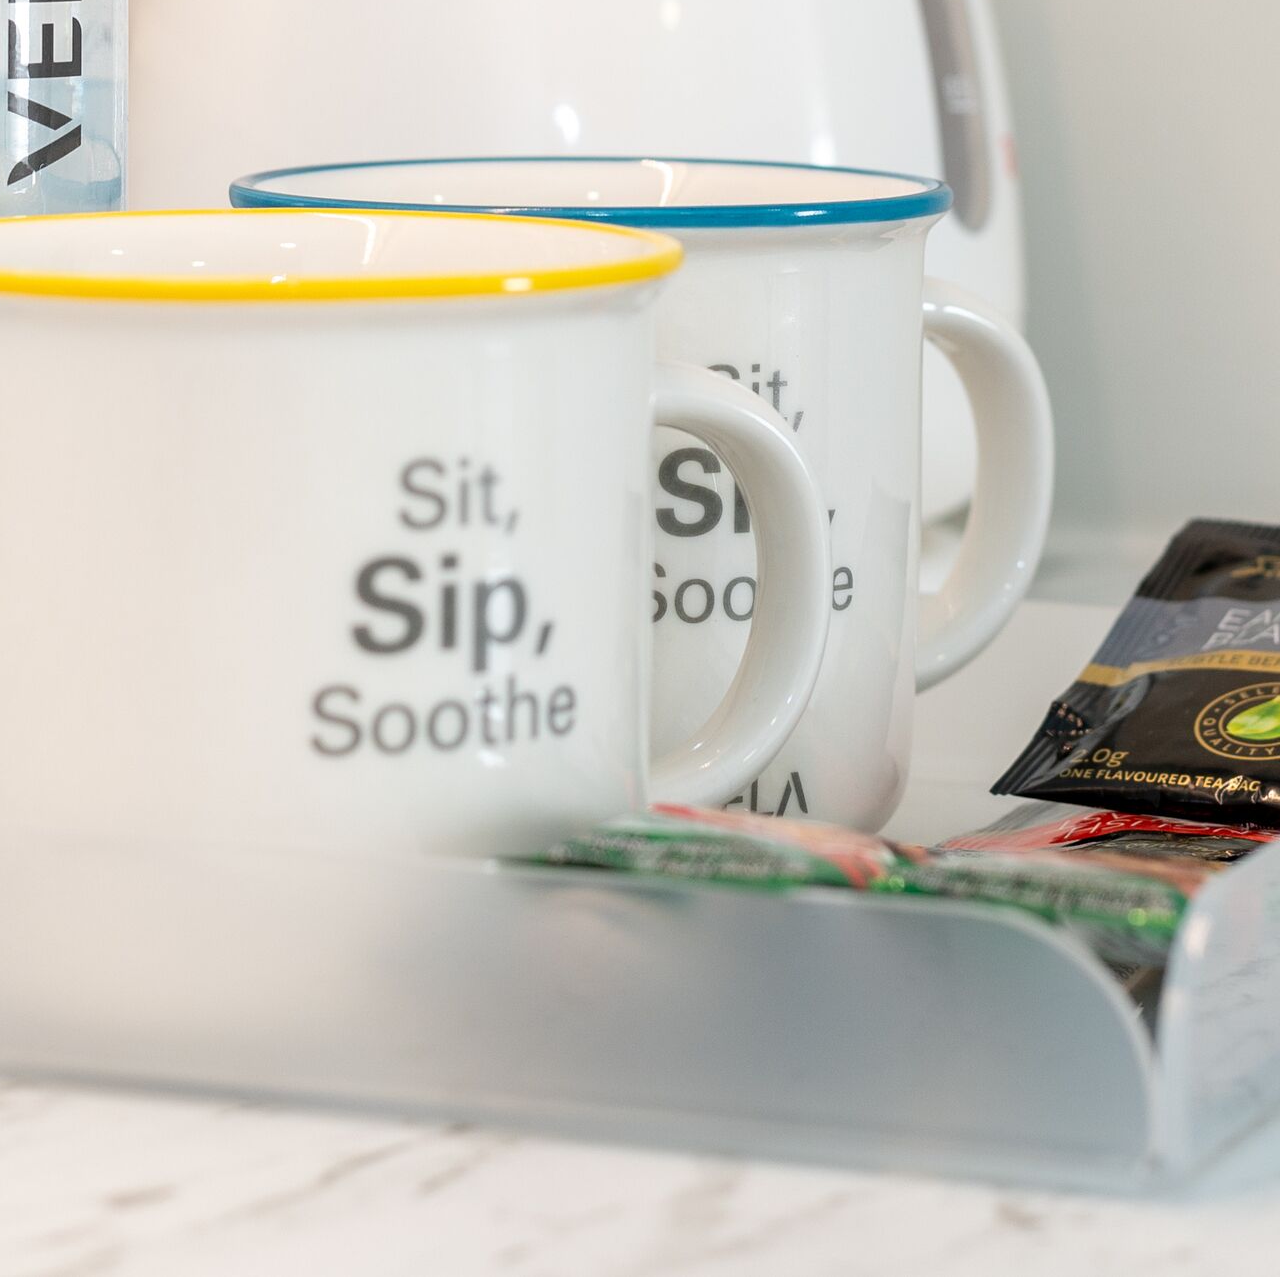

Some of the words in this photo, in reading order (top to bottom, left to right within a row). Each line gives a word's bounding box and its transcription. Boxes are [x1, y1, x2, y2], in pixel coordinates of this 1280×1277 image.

[397, 457, 520, 535] Sit,
[351, 555, 558, 674] Sip,
[652, 562, 854, 625] Sooe
[309, 676, 578, 759] Soothe
[1095, 769, 1193, 788] FLAVOURED
[1194, 775, 1224, 790] TEA
